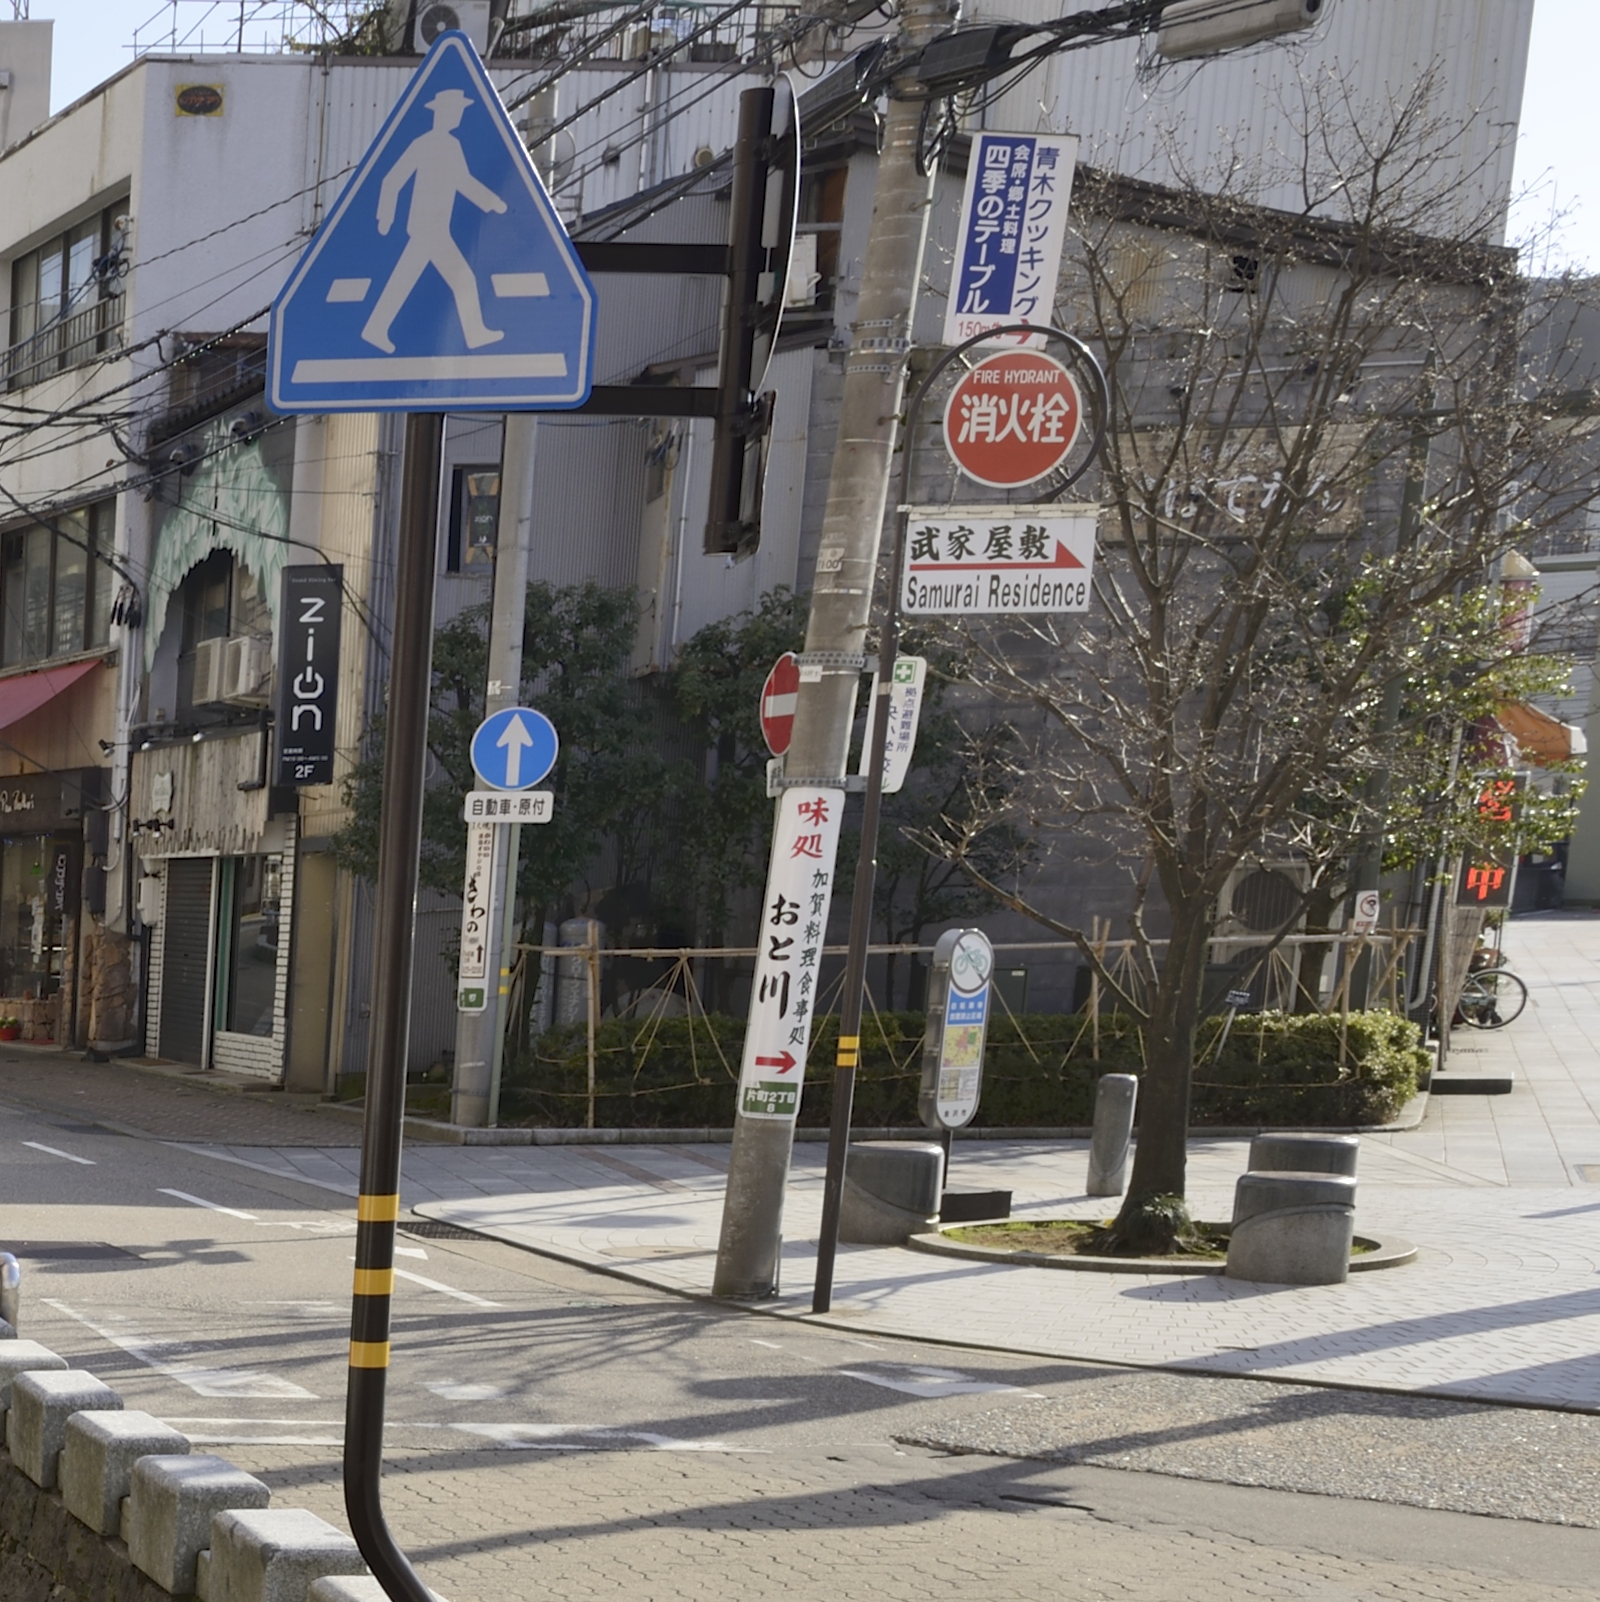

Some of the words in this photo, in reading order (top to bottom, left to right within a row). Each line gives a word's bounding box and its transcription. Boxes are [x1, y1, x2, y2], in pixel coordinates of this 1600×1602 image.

[999, 144, 1031, 254] 会席・郷土料理
[961, 144, 1011, 314] 四季のテーブル
[973, 369, 1001, 384] FIRE
[1004, 369, 1062, 384] HYDRANT
[957, 392, 1070, 444] 消火栓
[910, 524, 1051, 561] 武家屋敷
[906, 574, 981, 609] Samurai
[987, 574, 1086, 608] Residence
[294, 764, 315, 779] 2F
[472, 798, 546, 816] 自動車・原付
[790, 796, 830, 860] 味処
[759, 892, 801, 1021] おと川
[788, 868, 829, 1046] 加賀料理食事処
[767, 1103, 776, 1113] 8
